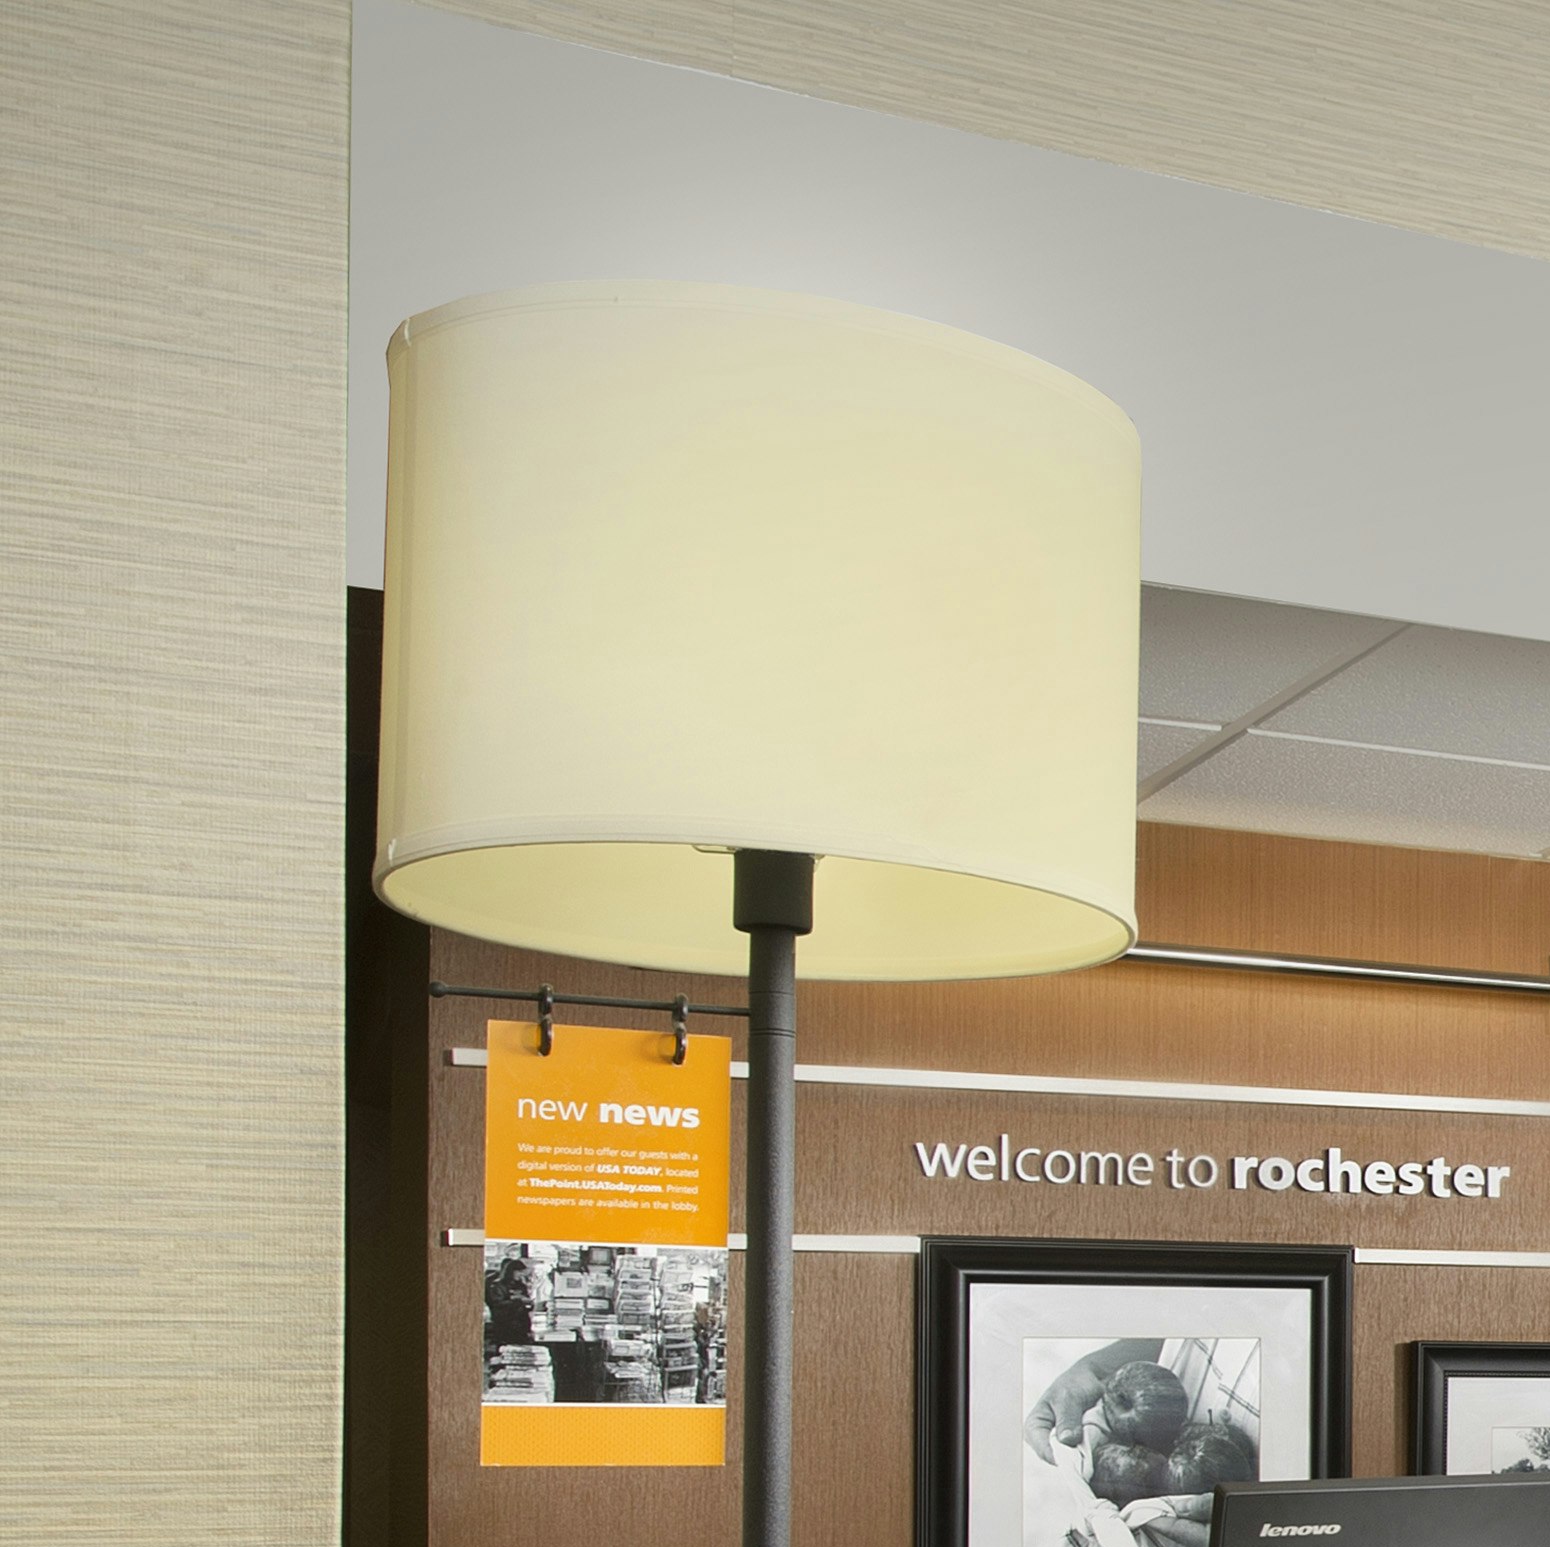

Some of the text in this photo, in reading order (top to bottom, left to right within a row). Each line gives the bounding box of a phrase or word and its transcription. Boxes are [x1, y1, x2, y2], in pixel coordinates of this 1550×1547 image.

[517, 1098, 700, 1128] new news
[518, 1143, 698, 1161] We are proud to offer our guests with a
[517, 1160, 547, 1172] digital
[549, 1163, 582, 1172] version
[584, 1163, 595, 1173] of
[597, 1164, 620, 1175] USA
[666, 1167, 699, 1178] located
[915, 1134, 1510, 1198] welcome to rochester
[517, 1178, 528, 1187] at
[667, 1184, 699, 1195] Printed
[517, 1195, 576, 1207] newspapers
[578, 1199, 593, 1208] are
[596, 1199, 638, 1209] available
[641, 1200, 650, 1209] in
[653, 1200, 668, 1211] the
[1259, 1523, 1341, 1537] lenovo
